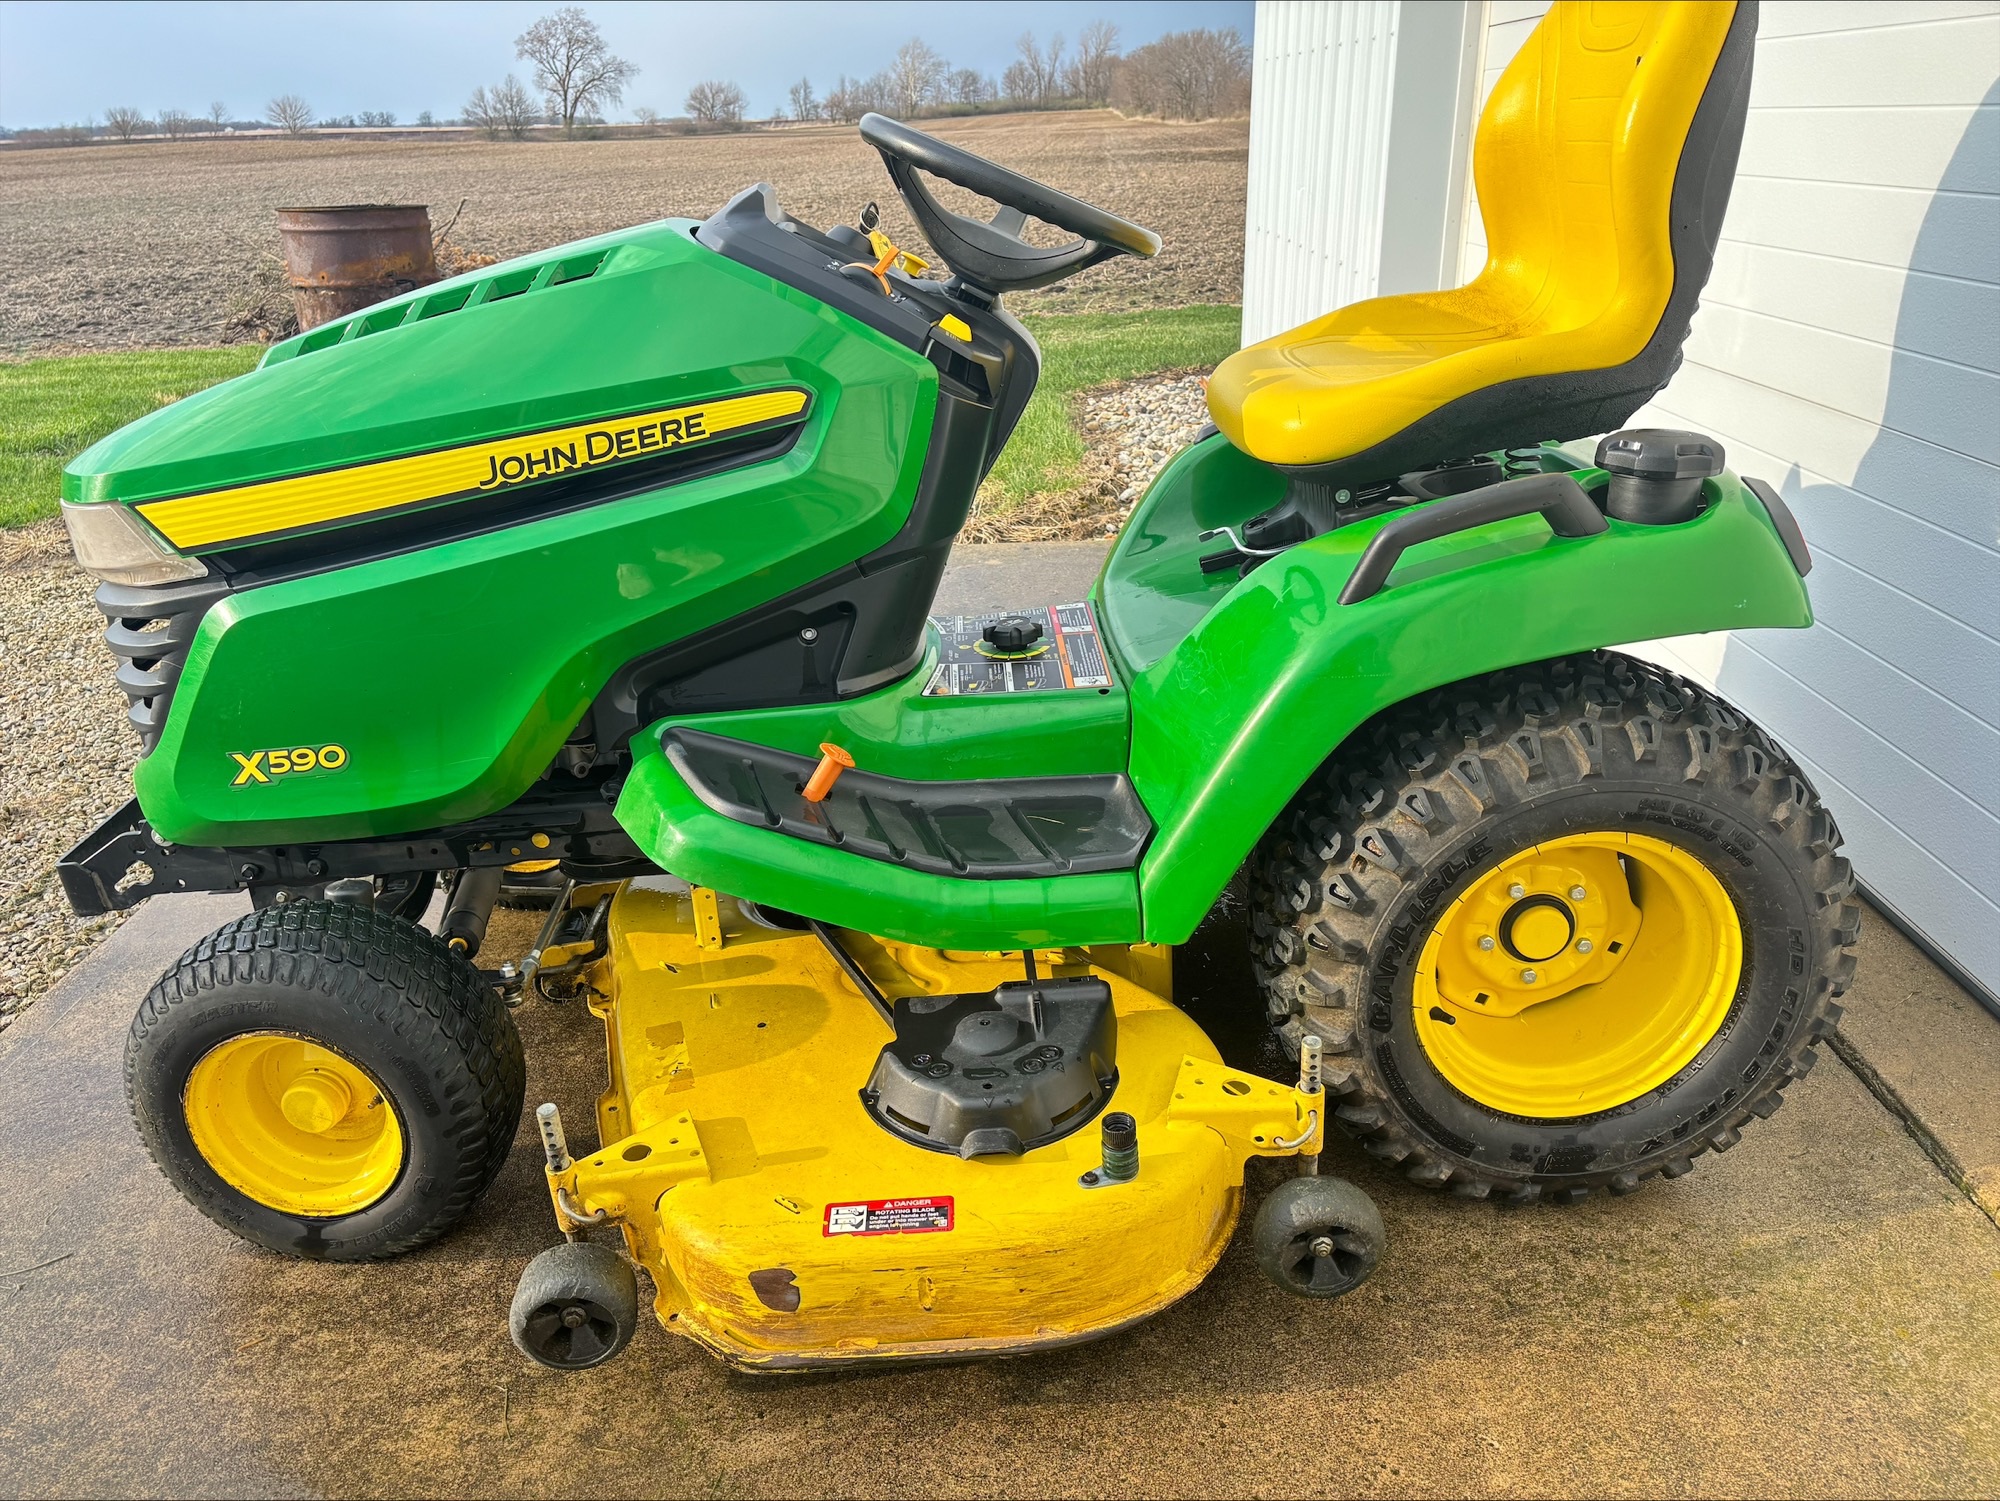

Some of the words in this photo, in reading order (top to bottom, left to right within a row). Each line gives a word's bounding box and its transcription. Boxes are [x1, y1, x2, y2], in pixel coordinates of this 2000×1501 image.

[479, 443, 579, 487] JOHN
[585, 412, 707, 463] DEERE
[231, 744, 347, 786] X590
[1368, 834, 1494, 1033] CARLISLE
[1786, 926, 1807, 976] HD
[1739, 985, 1801, 1084] FIELD
[1637, 1087, 1739, 1156] TRAX
[894, 1199, 932, 1207] DANGER
